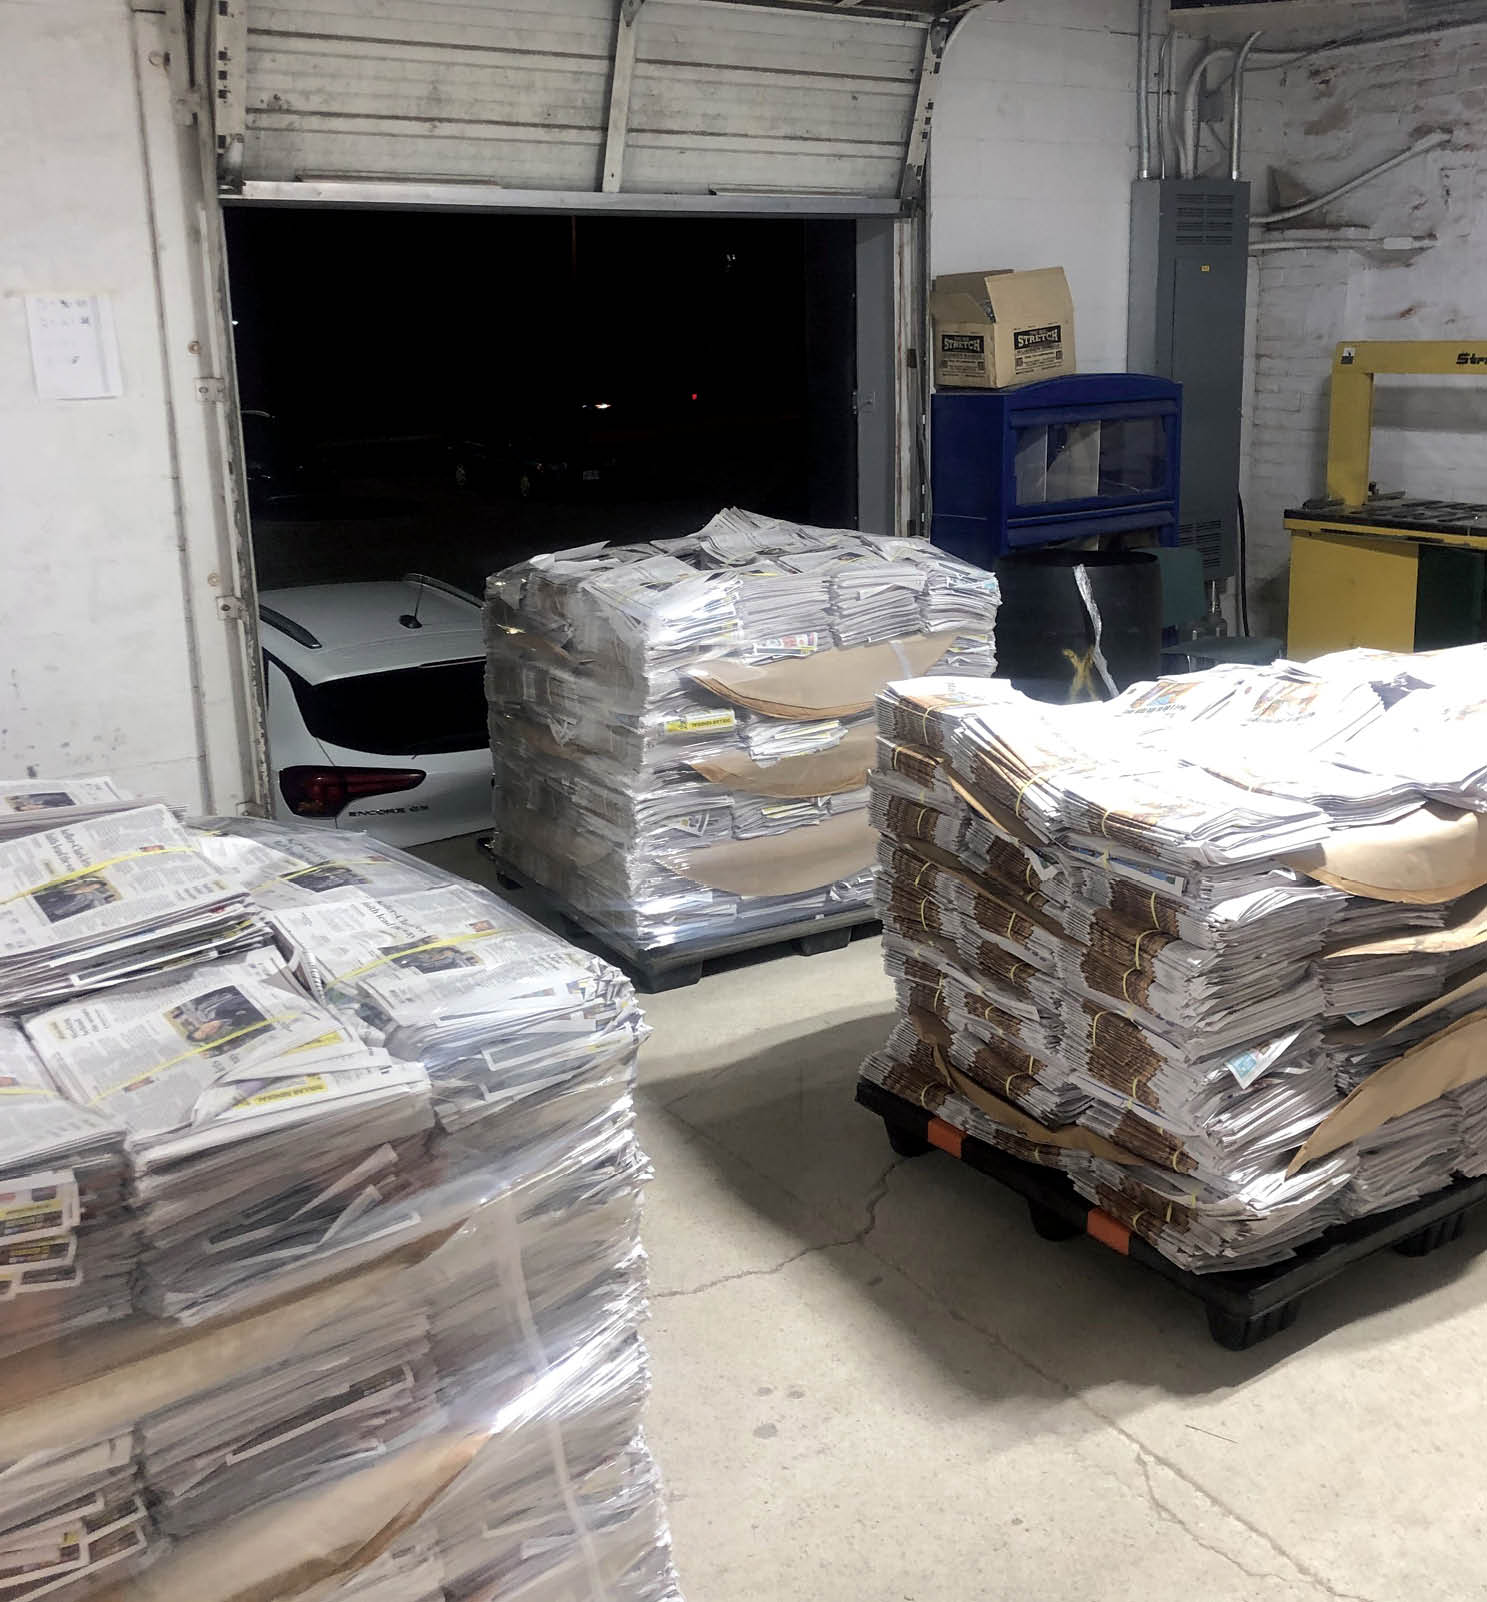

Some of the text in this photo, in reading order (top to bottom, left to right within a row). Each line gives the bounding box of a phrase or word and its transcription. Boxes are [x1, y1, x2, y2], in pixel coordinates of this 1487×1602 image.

[944, 338, 980, 351] STRETCH
[1018, 329, 1058, 347] STRETCH
[349, 807, 406, 817] ENCORE
